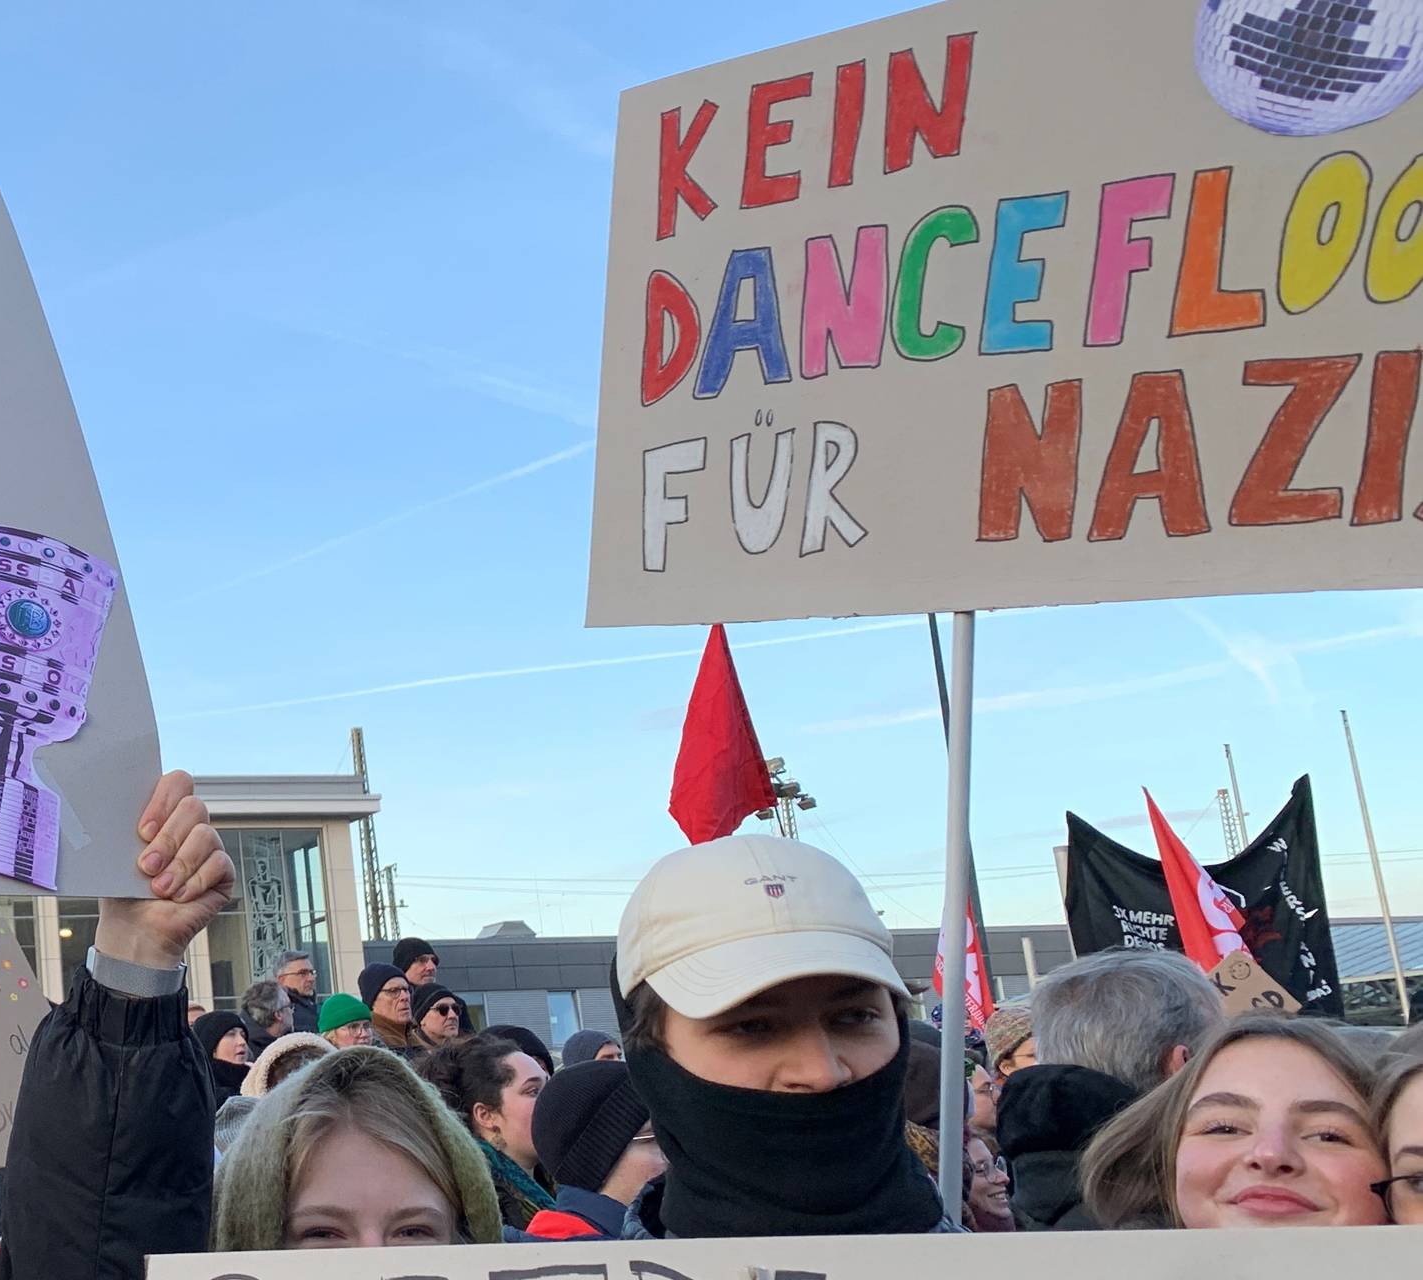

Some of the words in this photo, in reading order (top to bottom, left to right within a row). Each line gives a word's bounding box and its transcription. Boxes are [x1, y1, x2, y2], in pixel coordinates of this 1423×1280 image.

[655, 31, 978, 242] KEIN
[640, 150, 1423, 407] DANCEFLOO
[642, 410, 868, 573] FÜR
[976, 346, 1423, 543] NAZI
[744, 874, 798, 886] GANT
[1129, 910, 1175, 927] MEHR
[1123, 935, 1166, 951] DEOS
